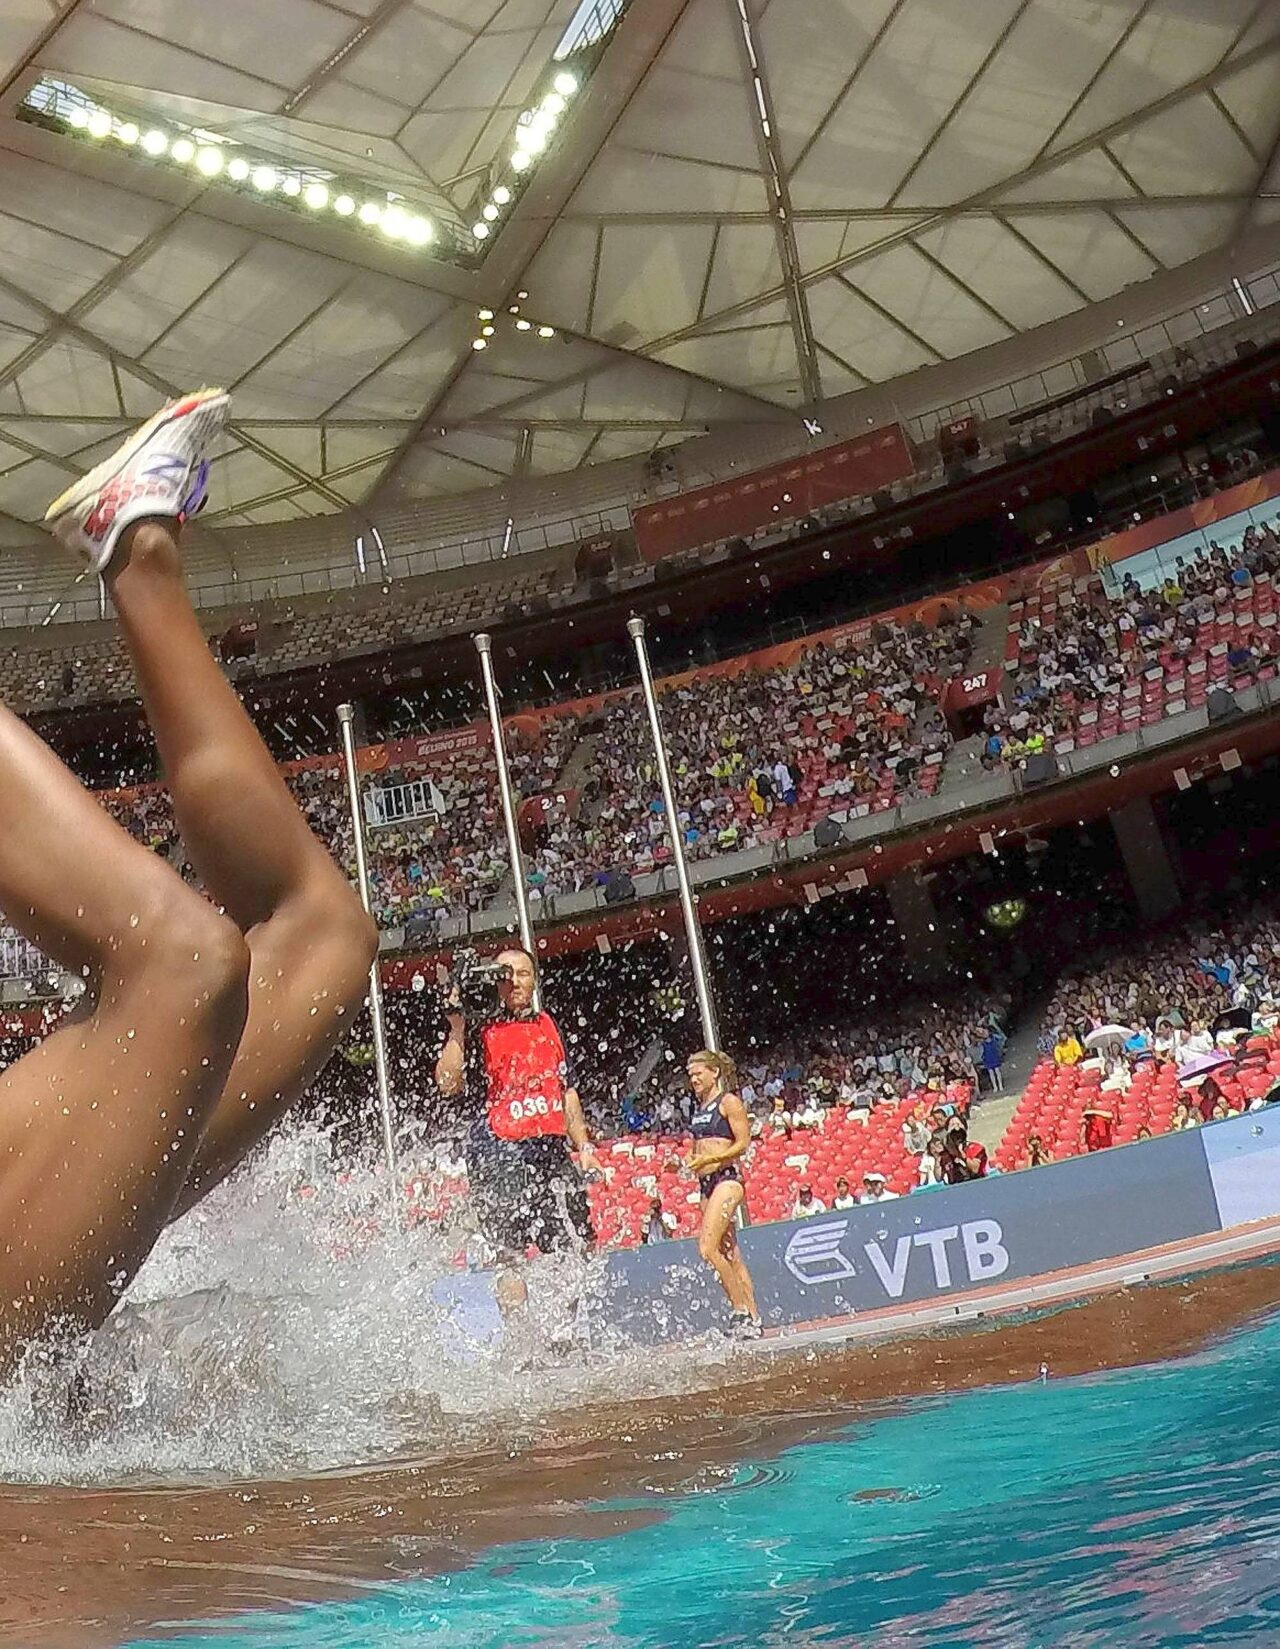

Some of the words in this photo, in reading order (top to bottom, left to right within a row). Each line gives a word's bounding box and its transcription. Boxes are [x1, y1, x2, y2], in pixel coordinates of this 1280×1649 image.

[962, 673, 987, 692] 247
[510, 1095, 549, 1120] 036
[863, 1219, 1010, 1298] VTB
